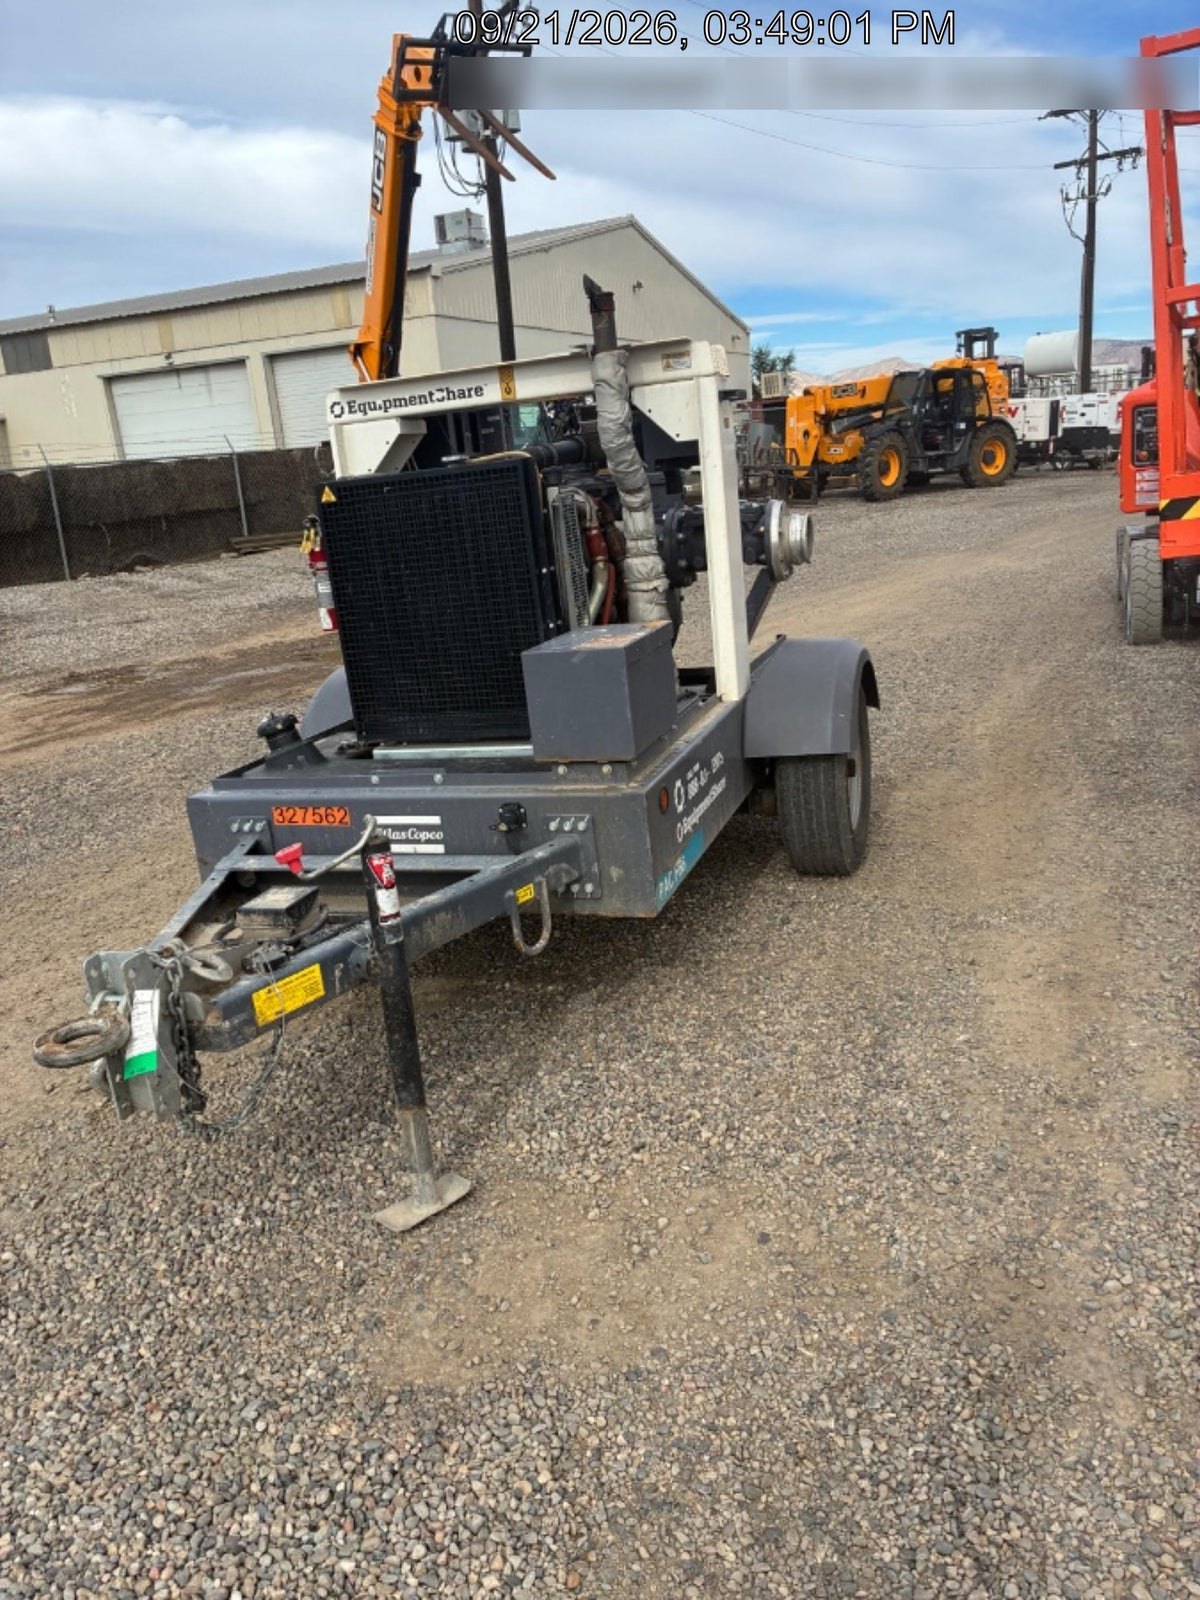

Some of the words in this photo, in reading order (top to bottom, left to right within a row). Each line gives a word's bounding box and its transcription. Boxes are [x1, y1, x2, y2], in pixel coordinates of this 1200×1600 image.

[373, 131, 386, 212] JCB
[832, 384, 857, 398] JCB
[273, 806, 349, 825] 327562
[376, 828, 407, 840] tlas
[408, 827, 444, 843] Copco
